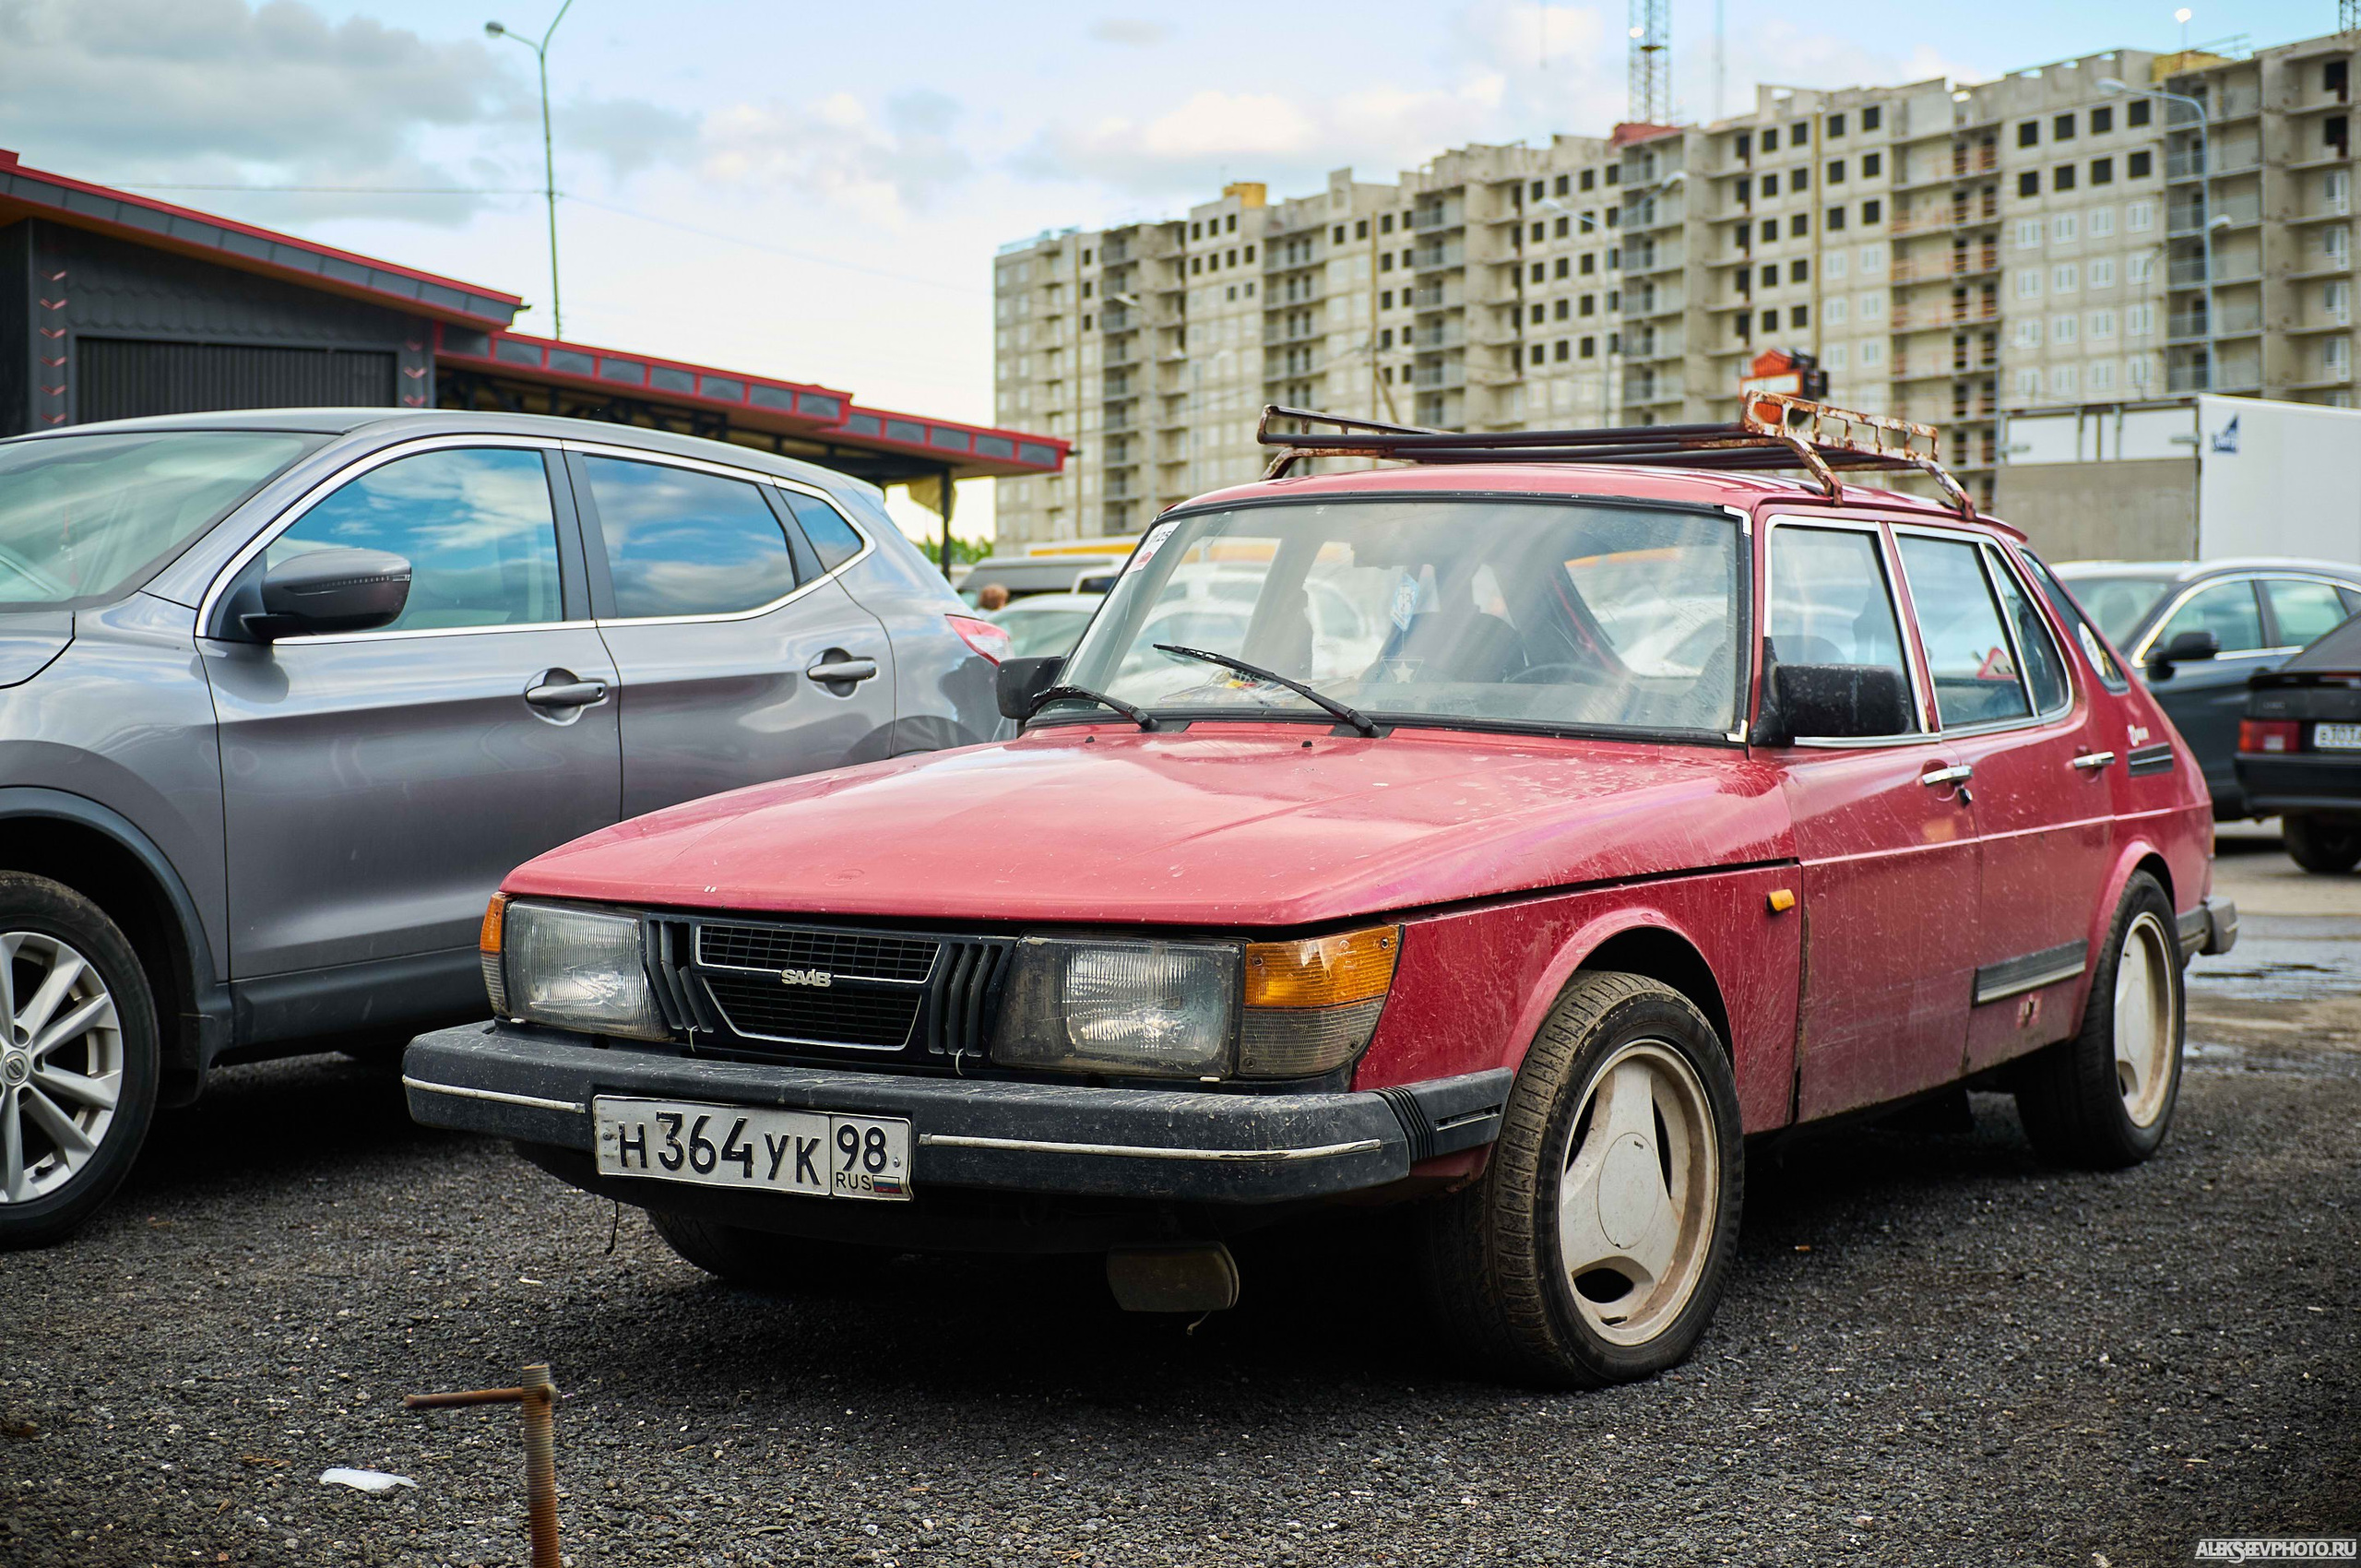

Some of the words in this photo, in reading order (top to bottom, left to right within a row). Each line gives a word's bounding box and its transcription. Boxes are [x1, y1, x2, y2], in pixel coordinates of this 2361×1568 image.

[781, 969, 832, 987] SAAB
[836, 1123, 887, 1173] 98
[836, 1171, 872, 1192] RUS
